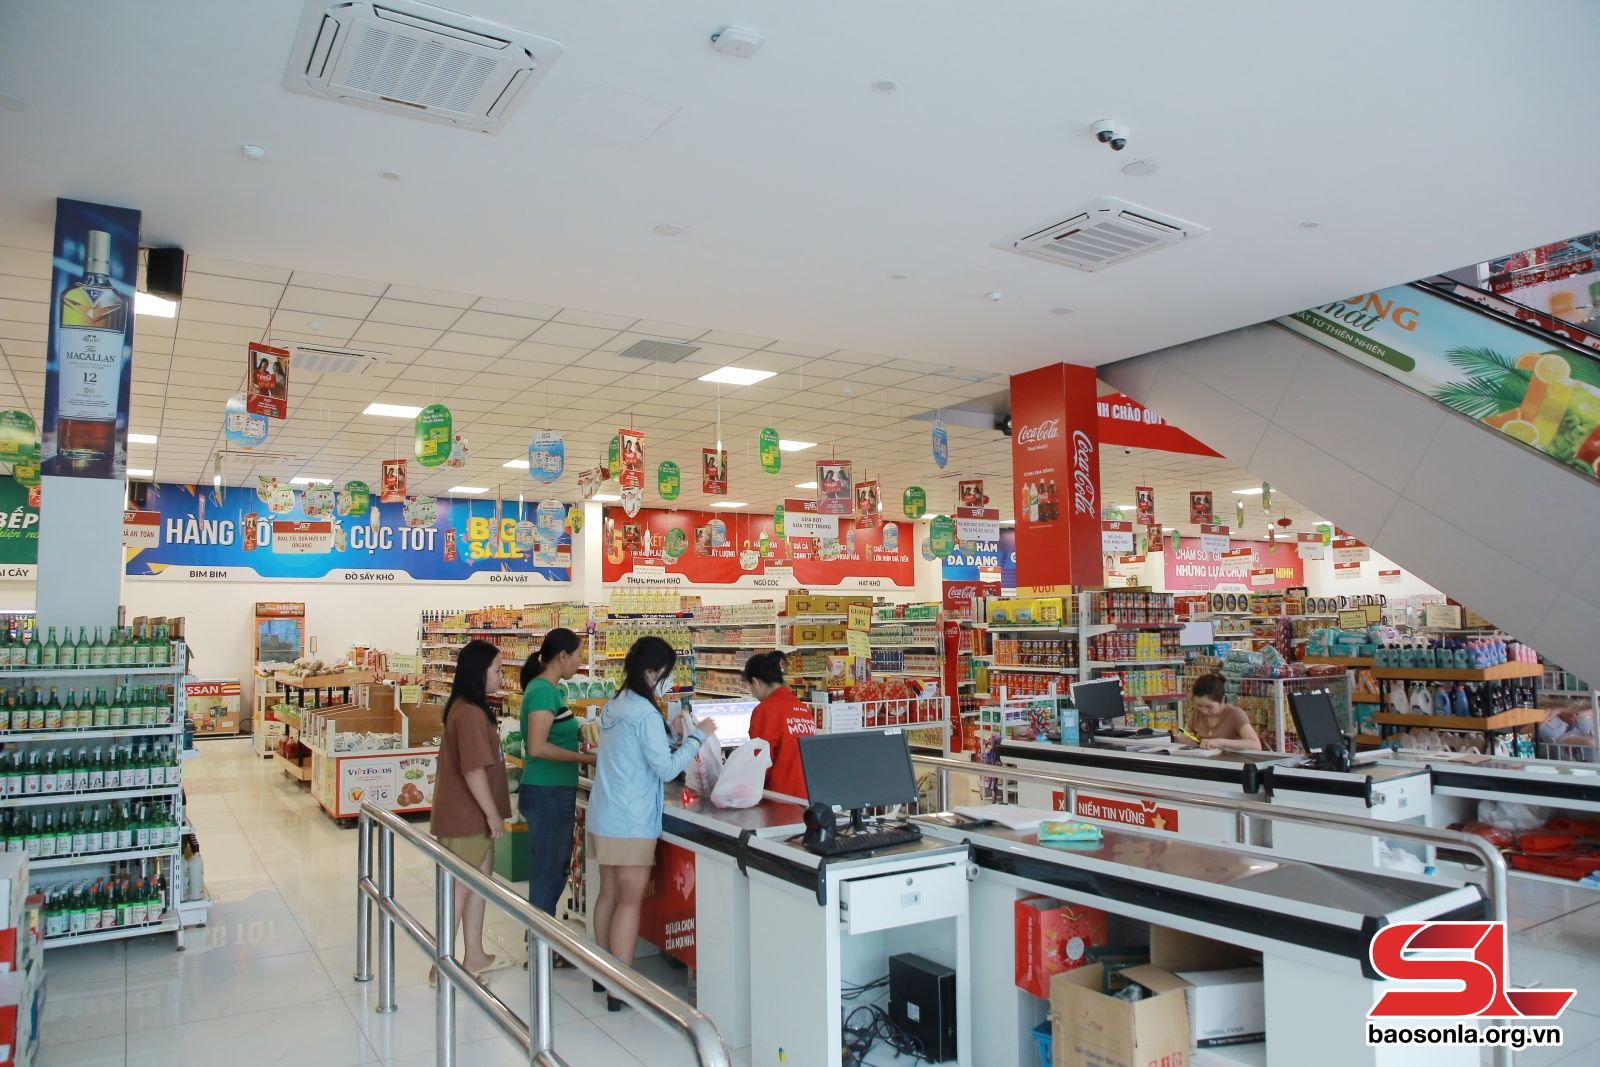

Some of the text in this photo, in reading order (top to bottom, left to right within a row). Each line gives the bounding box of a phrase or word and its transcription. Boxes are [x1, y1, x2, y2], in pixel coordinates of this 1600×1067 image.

[1354, 338, 1387, 358] NHIÊN
[66, 351, 116, 363] MACALLAN
[83, 371, 98, 383] 12
[1112, 402, 1141, 422] CHÀO
[130, 530, 138, 538] AN
[166, 513, 235, 546] HÀNG
[8, 567, 30, 577] CÂY
[189, 570, 227, 579] BIM BIM
[1175, 562, 1207, 577] NHỮNG
[1275, 567, 1294, 578] MINH
[1102, 806, 1117, 820] TIN
[1118, 808, 1145, 825] VỮNG
